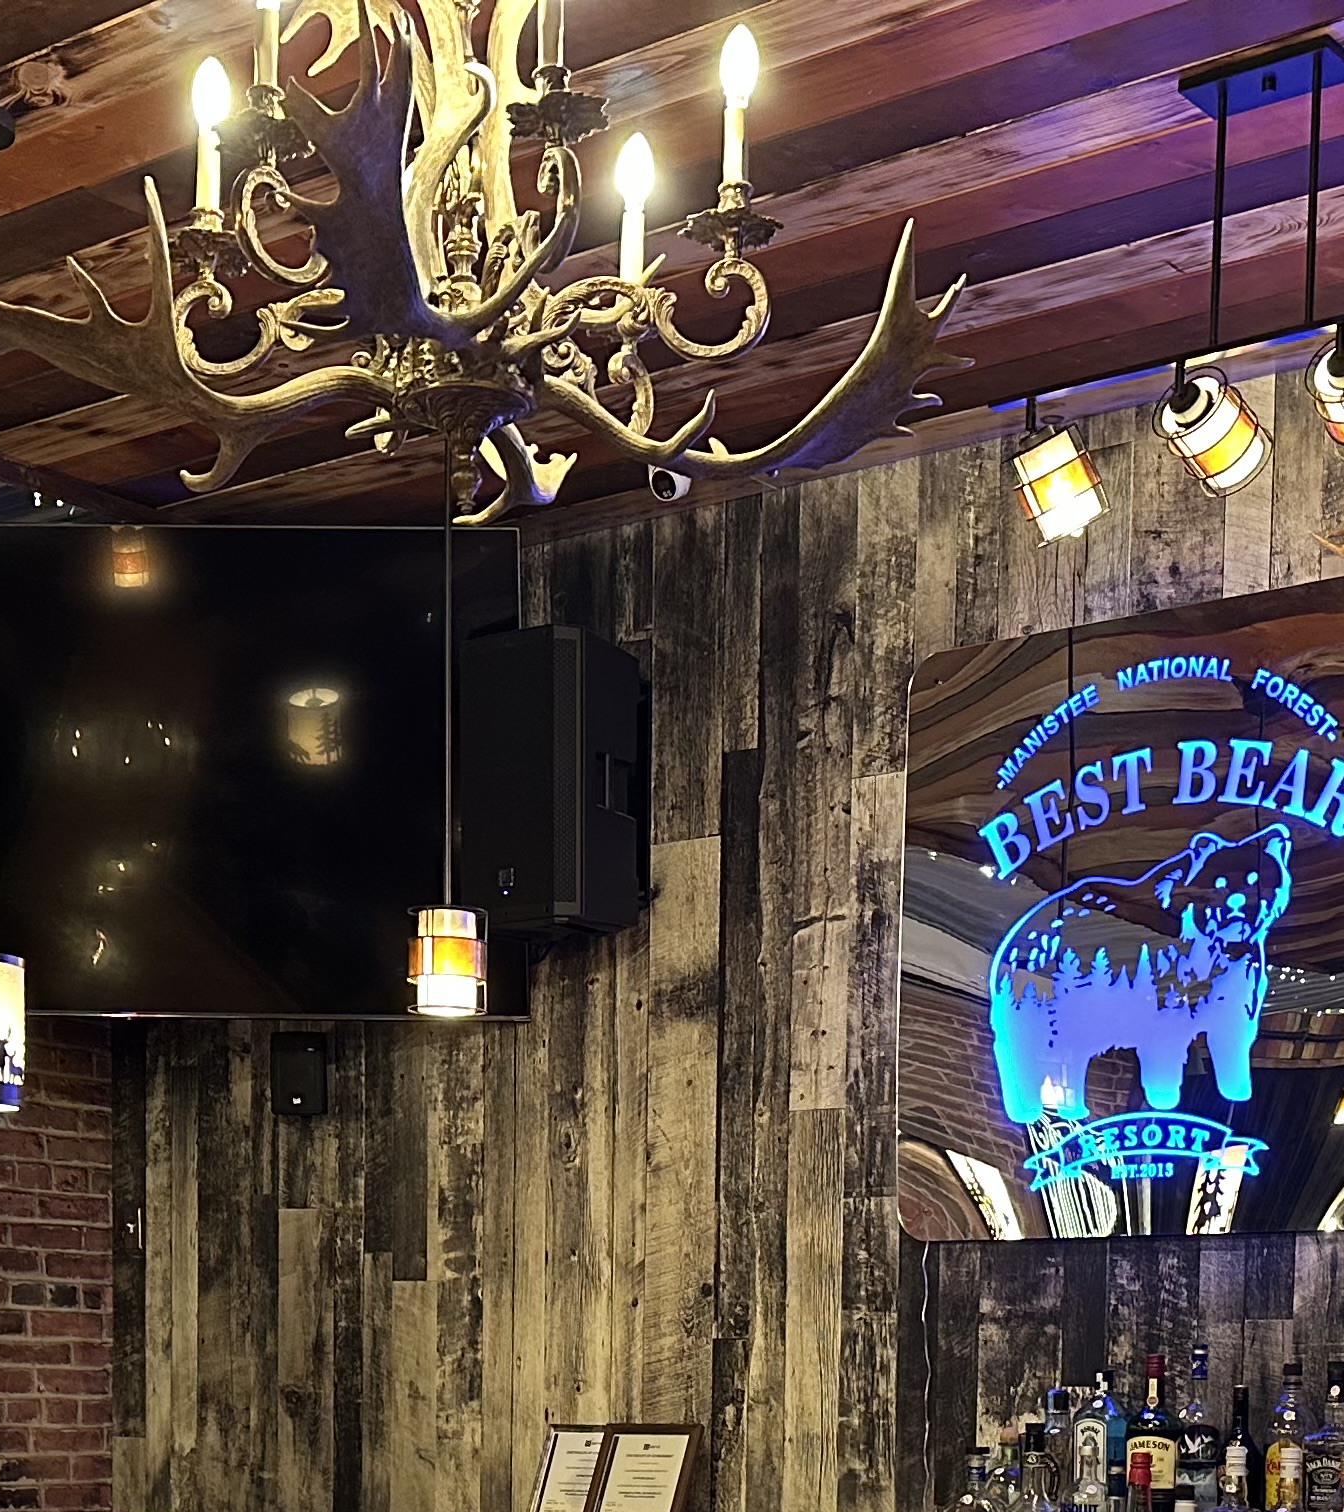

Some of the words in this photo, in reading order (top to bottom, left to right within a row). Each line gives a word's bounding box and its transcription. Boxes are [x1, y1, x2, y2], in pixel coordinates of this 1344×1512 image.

[1115, 655, 1233, 690] NATIONAL
[977, 747, 1153, 880] BEST
[1078, 1124, 1209, 1157] RESORT
[1129, 1440, 1171, 1452] JAMESON
[1306, 1461, 1323, 1473] JACK
